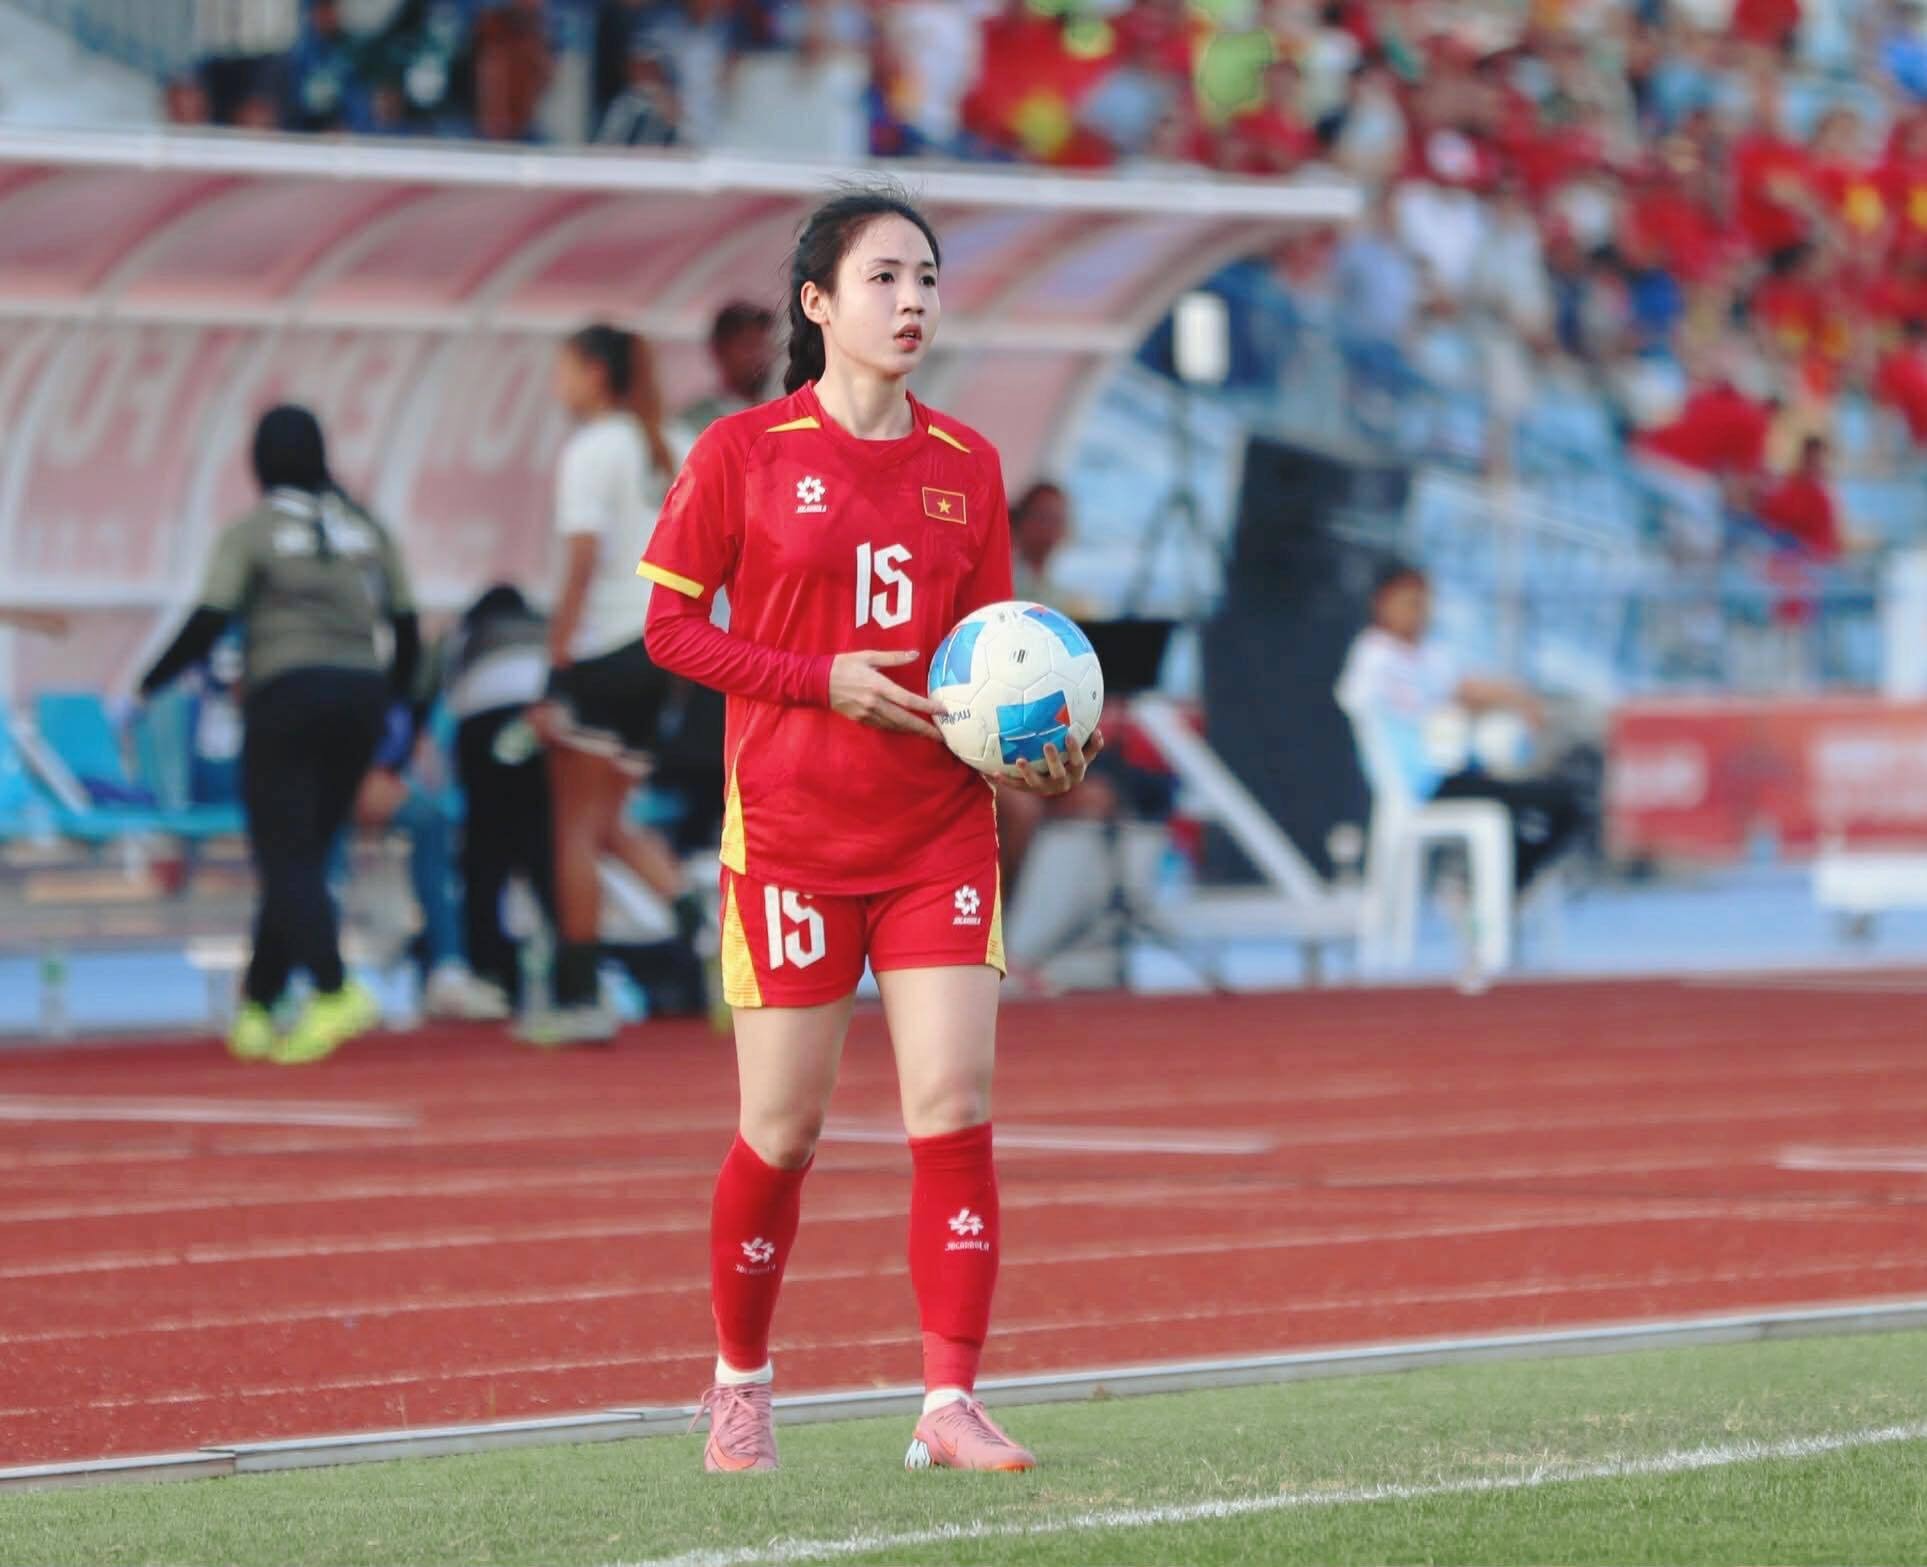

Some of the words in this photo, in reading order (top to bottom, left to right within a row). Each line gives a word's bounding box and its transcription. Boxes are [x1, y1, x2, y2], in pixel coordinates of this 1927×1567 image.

[855, 541, 913, 630] 15
[938, 708, 971, 725] molt
[763, 885, 826, 970] 15
